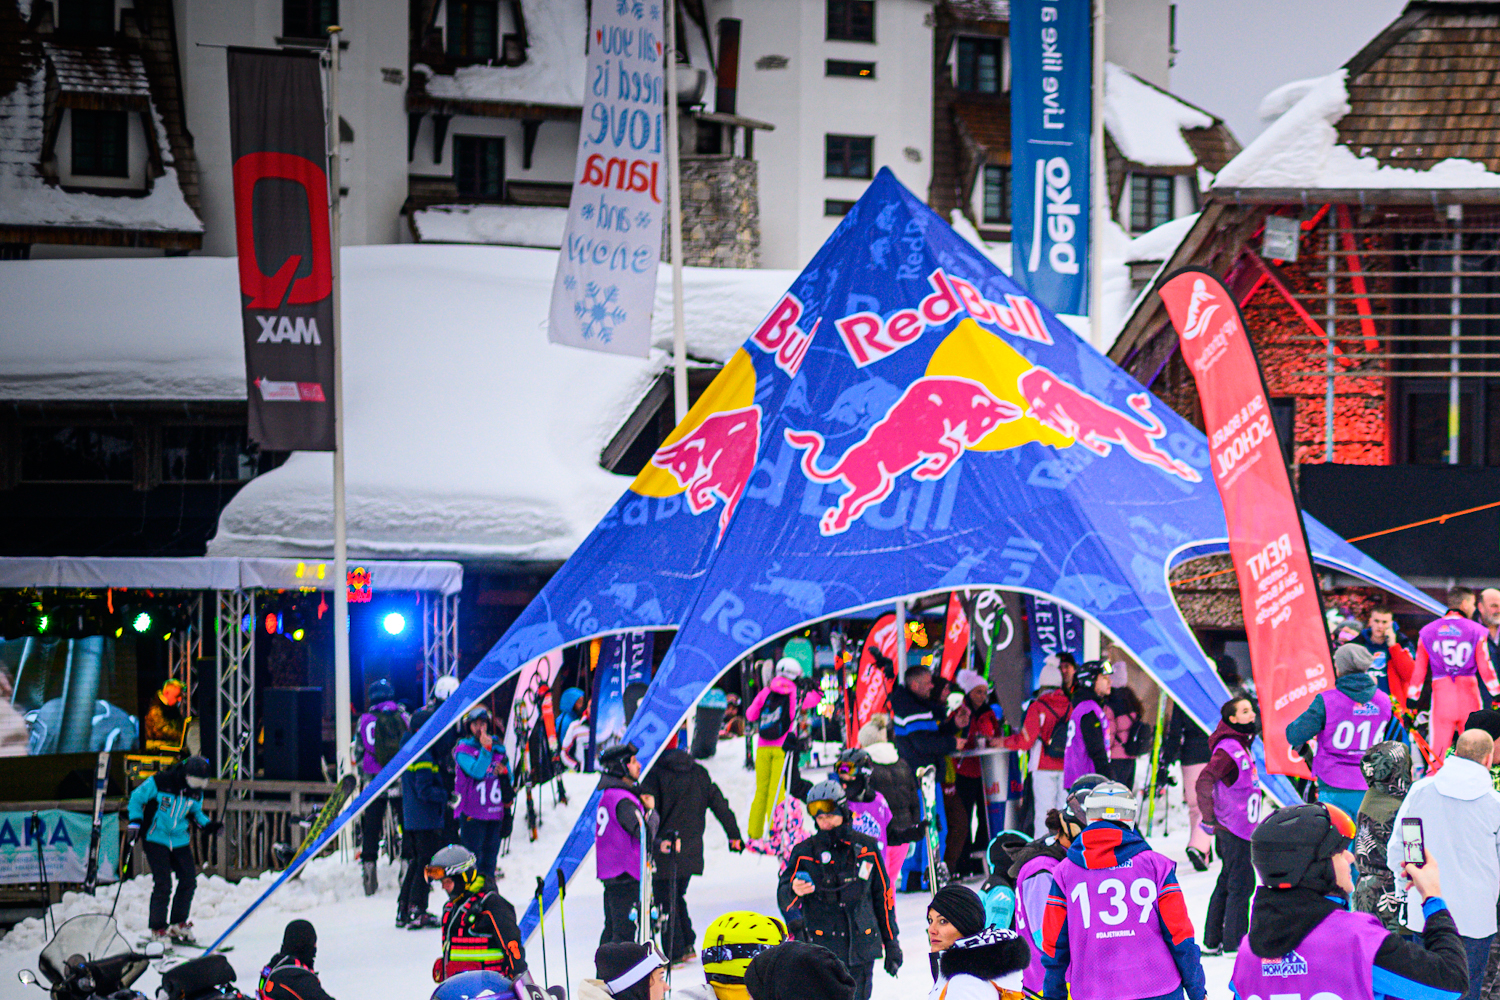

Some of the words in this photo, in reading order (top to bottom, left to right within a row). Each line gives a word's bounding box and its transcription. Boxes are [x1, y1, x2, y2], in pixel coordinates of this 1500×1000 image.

[835, 268, 963, 369] Red
[947, 274, 1054, 345] Bull
[1071, 878, 1158, 929] 139
